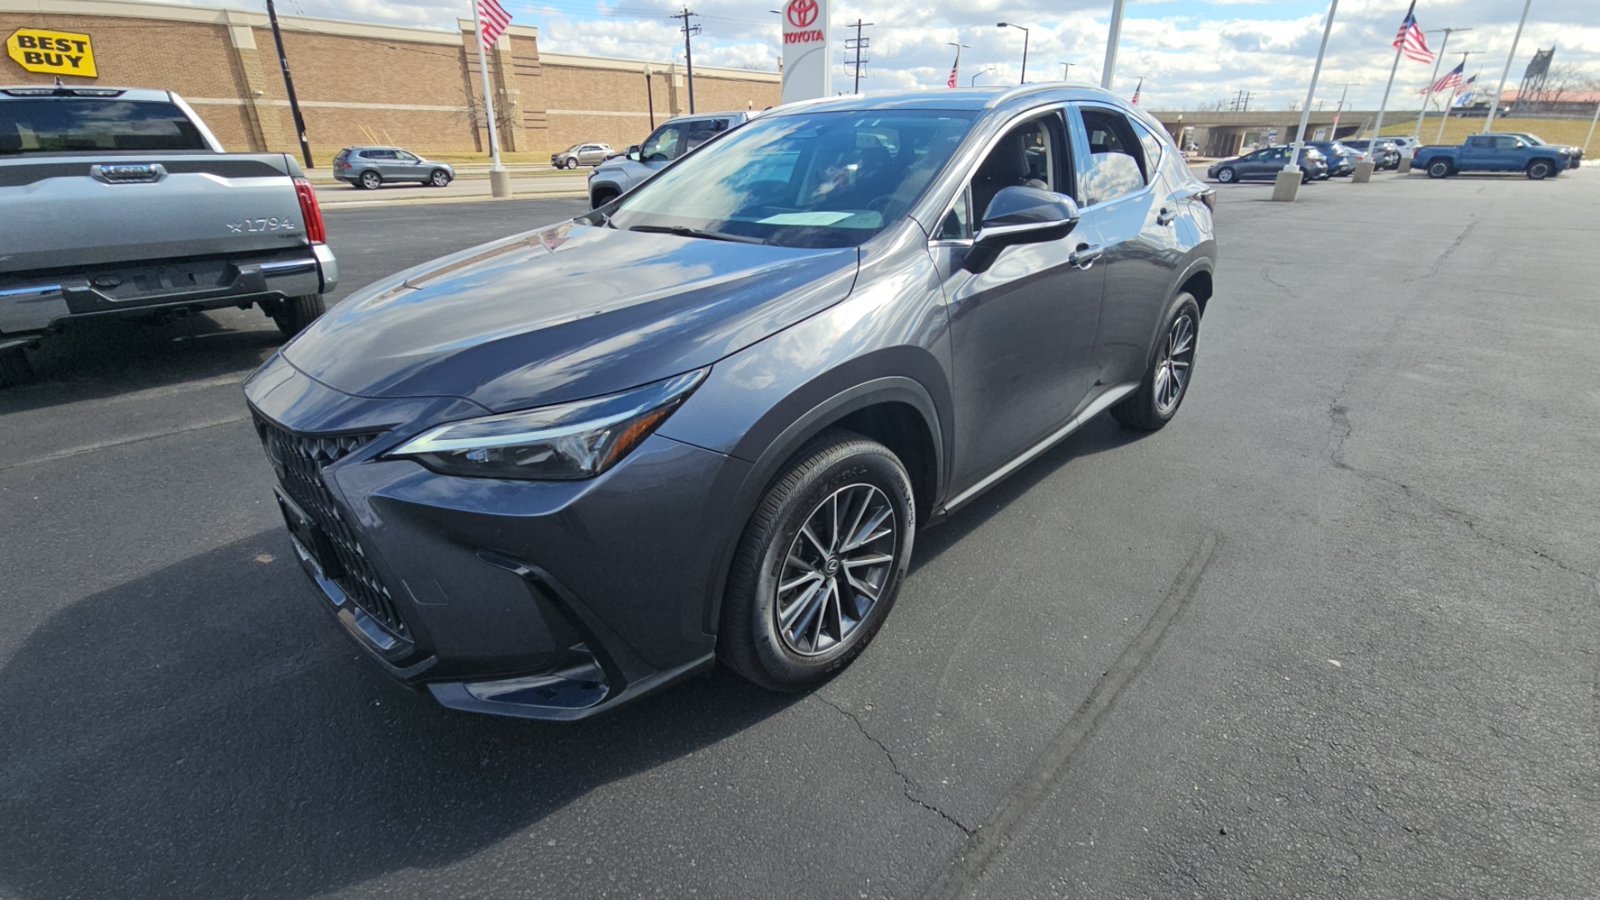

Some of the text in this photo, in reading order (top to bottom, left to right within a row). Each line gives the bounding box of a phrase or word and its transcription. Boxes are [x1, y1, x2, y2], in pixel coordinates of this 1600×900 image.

[17, 35, 87, 53] BEST
[783, 29, 824, 44] TOYOTA
[23, 51, 83, 68] BUY
[245, 217, 295, 232] 1794
